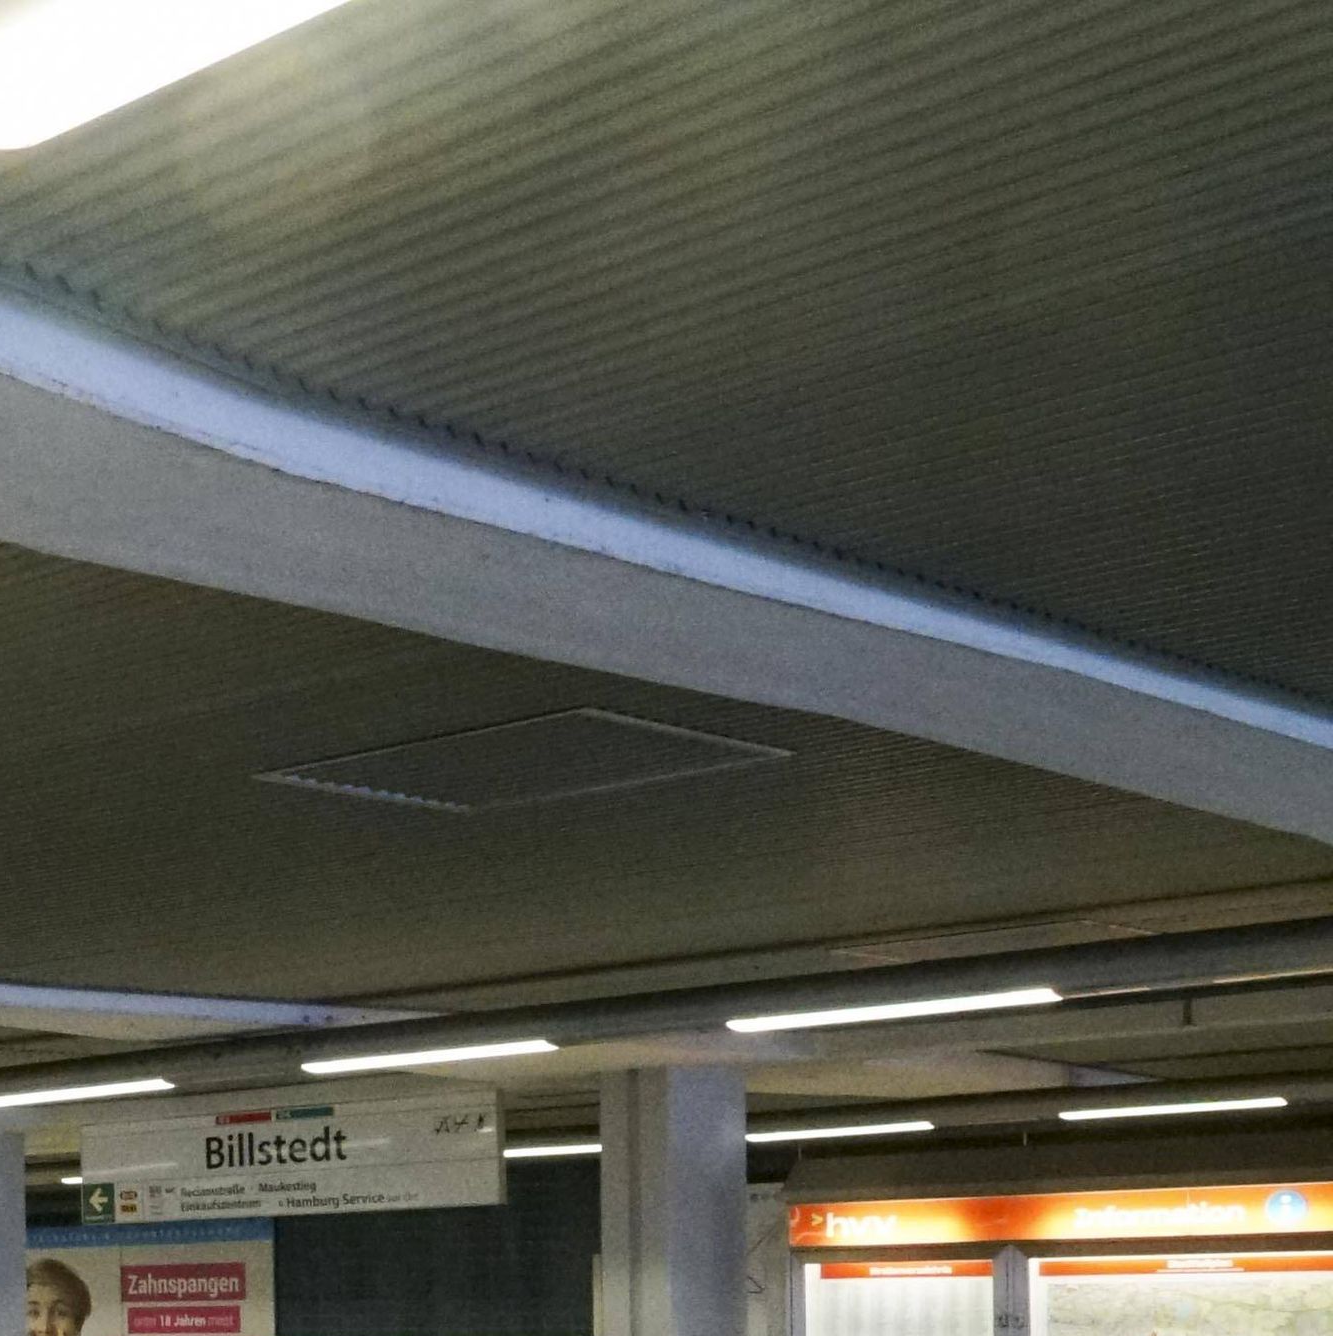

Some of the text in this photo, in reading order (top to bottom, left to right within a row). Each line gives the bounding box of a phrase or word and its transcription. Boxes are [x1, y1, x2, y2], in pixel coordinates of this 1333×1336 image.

[204, 1126, 348, 1170] Billstedt
[286, 1195, 340, 1209] Hamburg
[342, 1193, 385, 1206] Service
[825, 1212, 898, 1238] hvv
[1074, 1200, 1245, 1229] Information
[127, 1273, 240, 1298] Zahnspangen
[174, 1314, 206, 1327] Jahren
